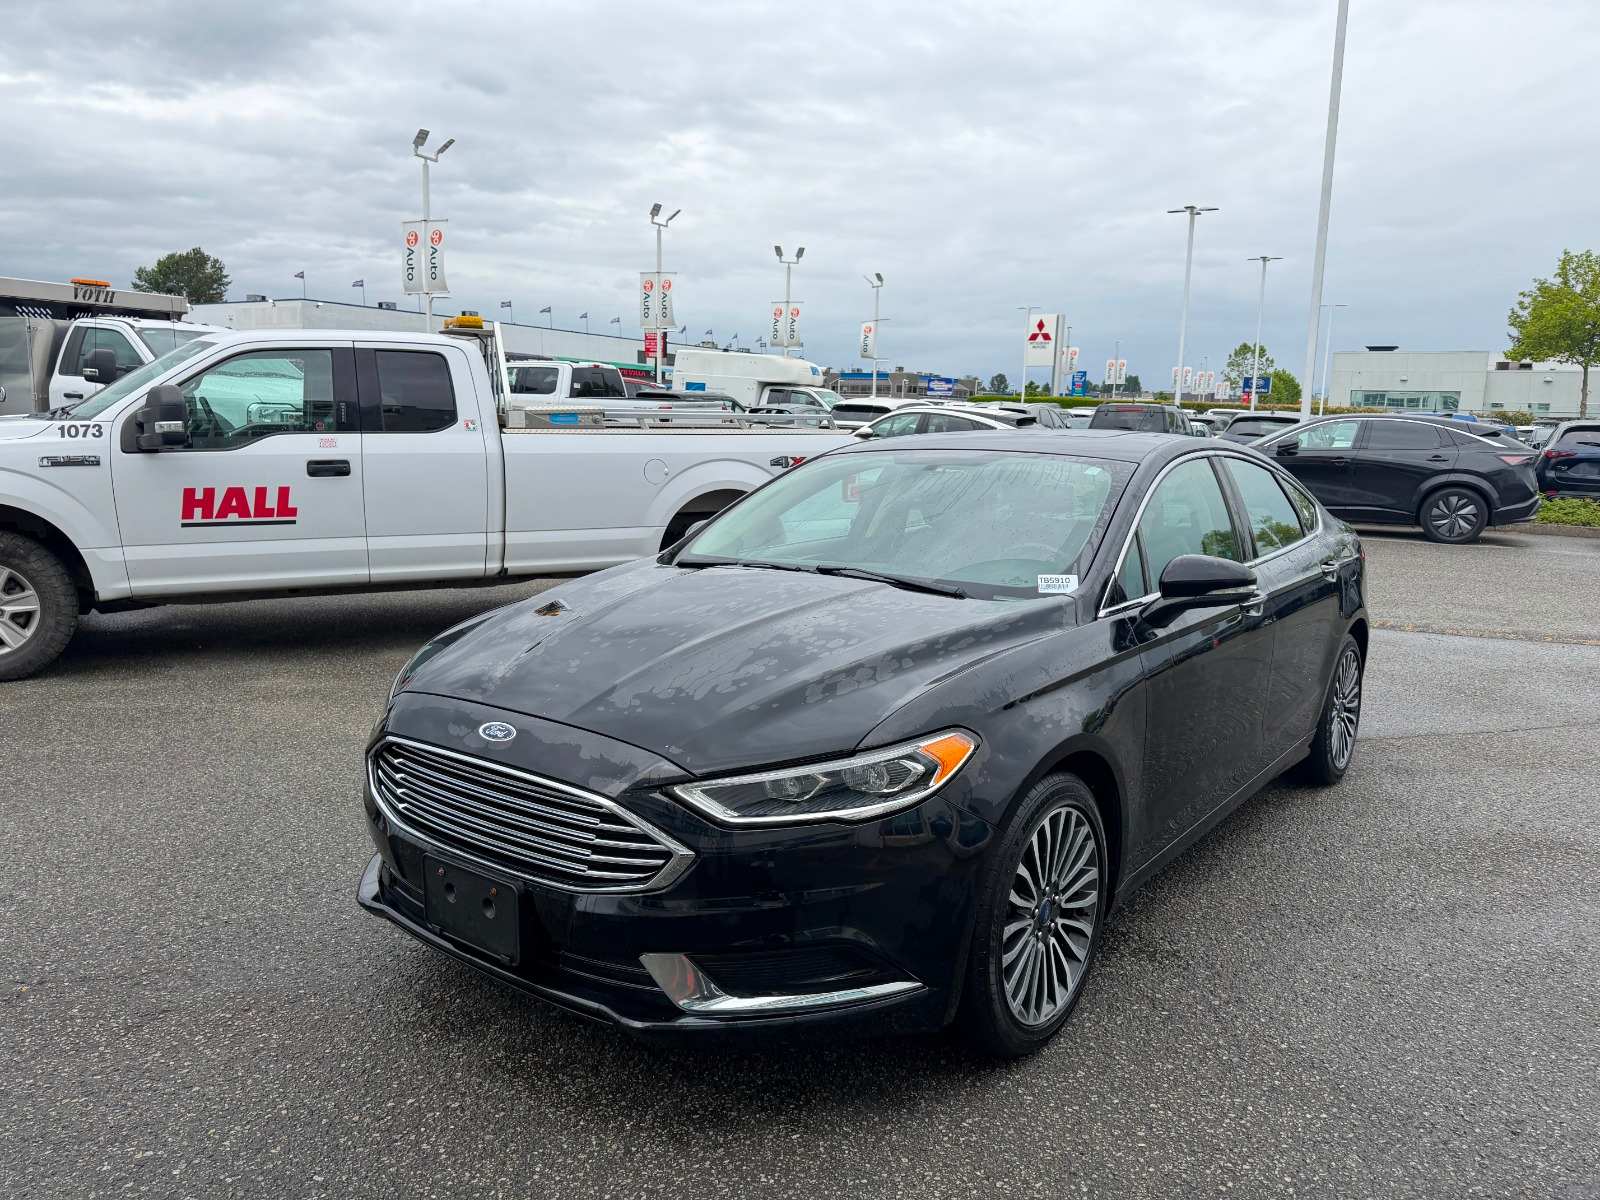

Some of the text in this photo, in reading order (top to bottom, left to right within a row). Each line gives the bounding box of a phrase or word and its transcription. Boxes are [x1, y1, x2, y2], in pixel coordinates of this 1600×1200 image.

[407, 247, 415, 281] Auto
[430, 246, 438, 281] Auto
[73, 287, 115, 304] VOTH
[57, 424, 104, 439] 1073
[181, 486, 298, 520] HALL
